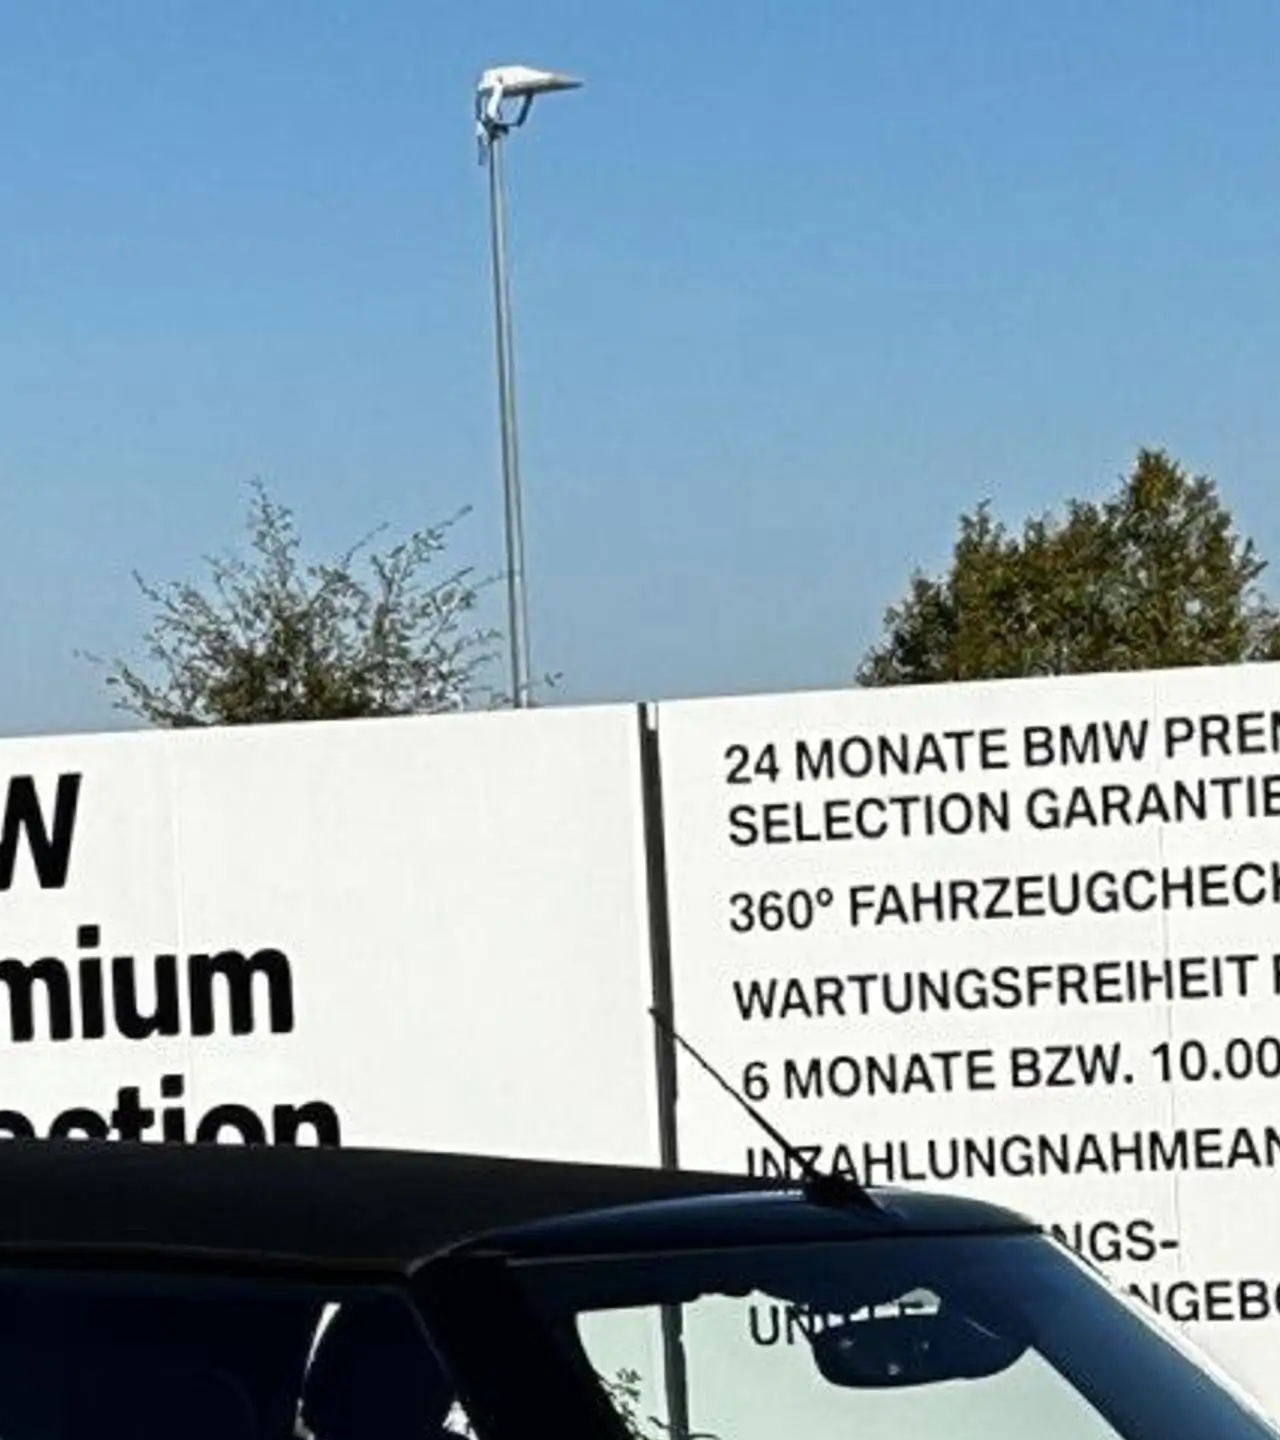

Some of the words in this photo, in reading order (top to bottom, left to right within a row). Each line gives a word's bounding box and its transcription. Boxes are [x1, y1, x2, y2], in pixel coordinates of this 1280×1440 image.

[726, 744, 779, 783] 24
[796, 729, 1008, 780] MONATE
[1024, 720, 1148, 766] BMW
[730, 792, 1008, 846] SELECTION
[731, 888, 833, 931] 360°
[734, 955, 1258, 1020] WARTUNGSFREIHEIT
[744, 1062, 769, 1100] 6
[785, 1050, 995, 1098] MONATE
[1011, 1044, 1132, 1087] BZW.
